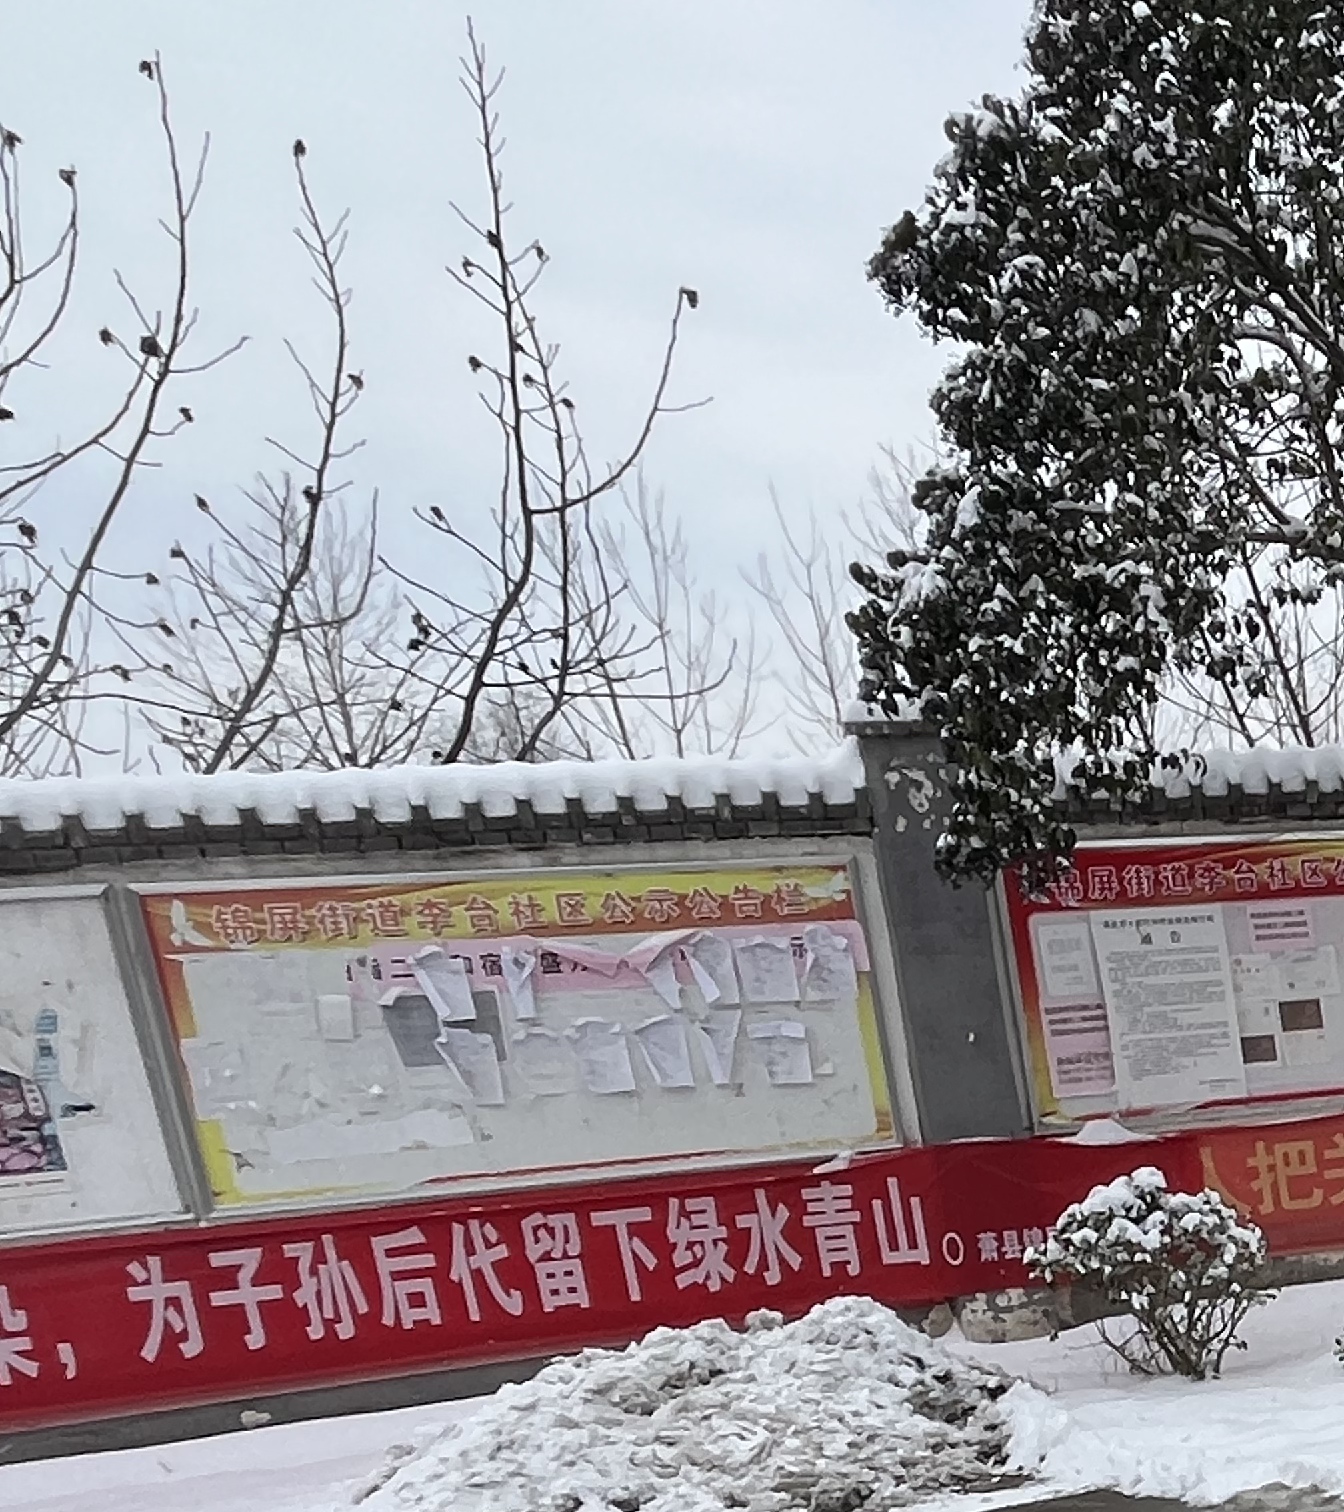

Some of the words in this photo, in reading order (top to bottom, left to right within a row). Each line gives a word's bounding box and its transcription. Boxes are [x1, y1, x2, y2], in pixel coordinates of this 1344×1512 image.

[211, 882, 812, 945] 锦屏街道李台社区公示公告栏
[976, 1226, 1059, 1263] 萧县锦
